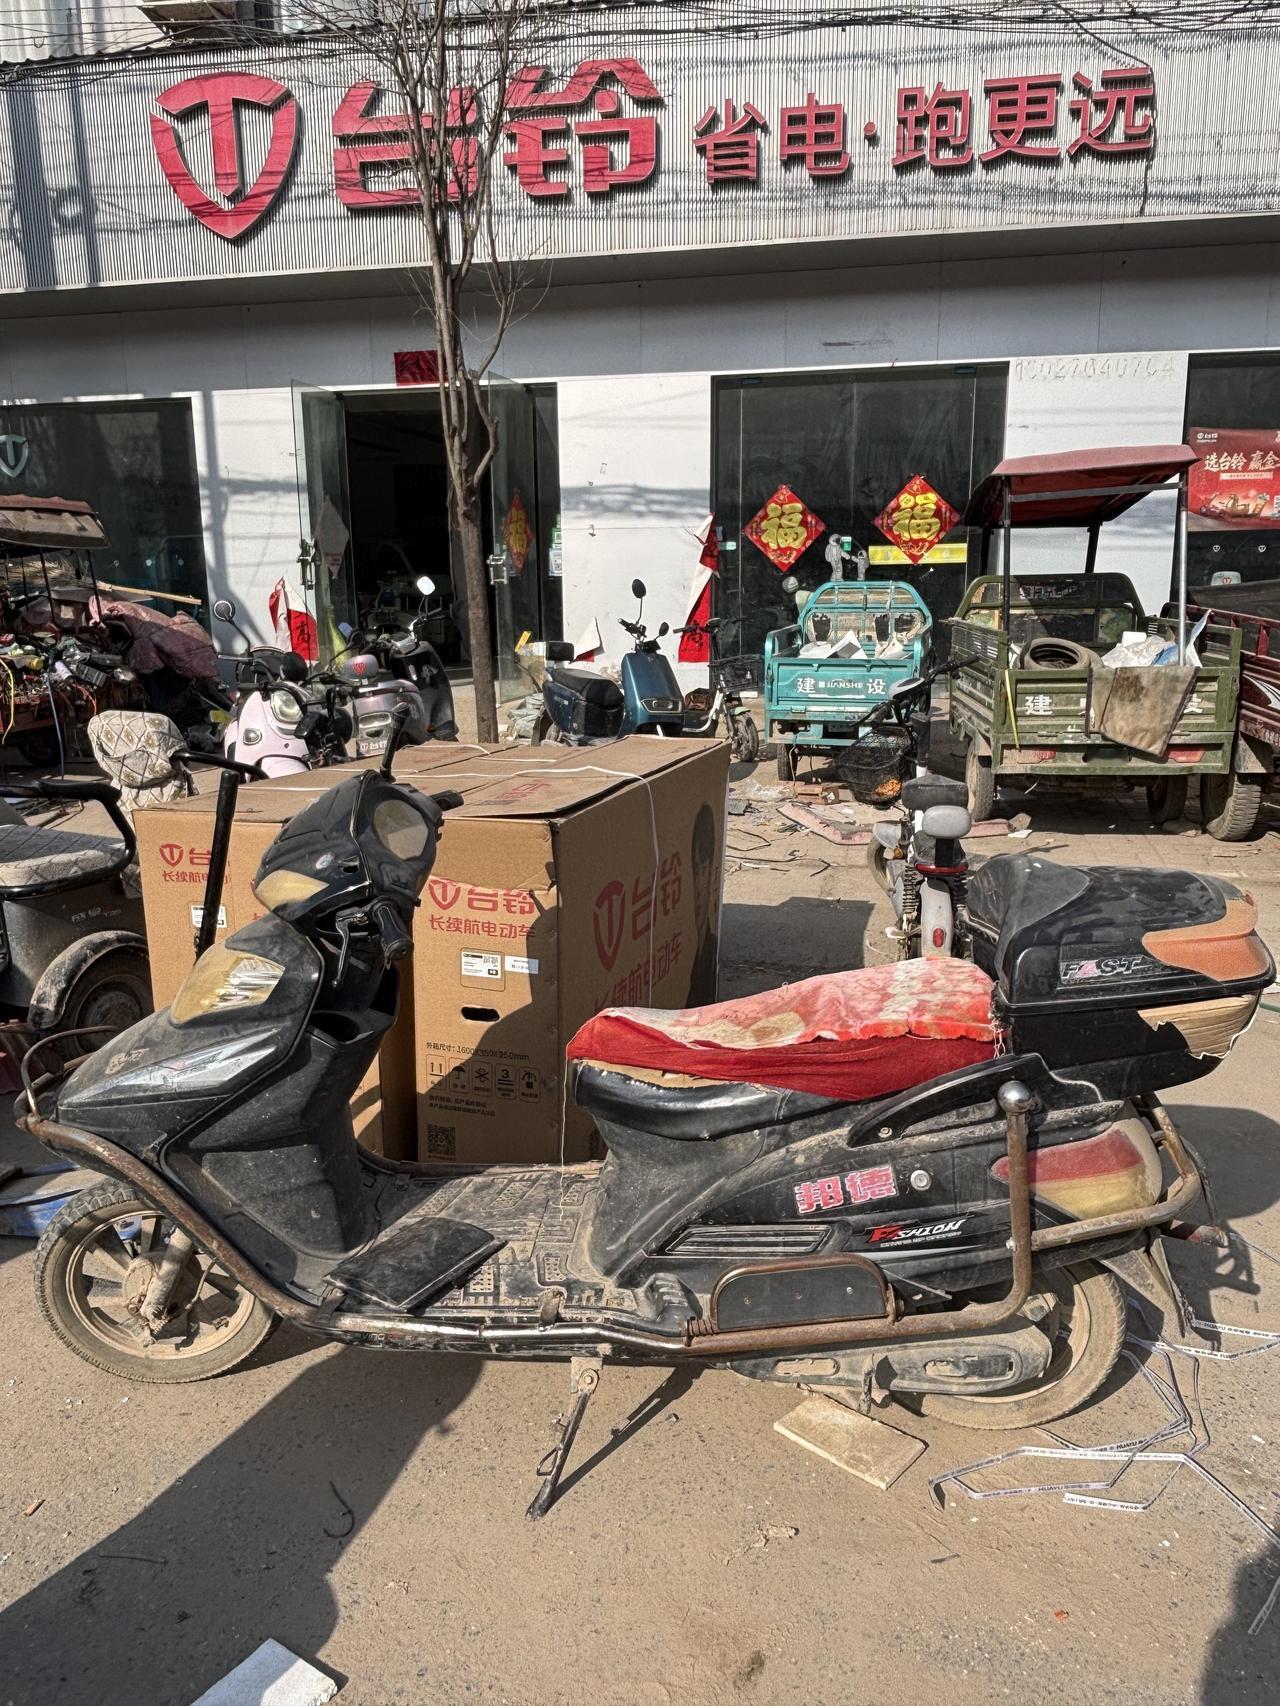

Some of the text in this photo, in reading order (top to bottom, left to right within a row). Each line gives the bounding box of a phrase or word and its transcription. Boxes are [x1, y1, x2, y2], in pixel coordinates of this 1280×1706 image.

[332, 57, 664, 209] 台铃
[1204, 452, 1247, 472] 选台铃
[761, 503, 808, 549] 福
[892, 493, 941, 541] 福
[796, 677, 816, 693] 建
[867, 678, 886, 695] 设
[1024, 694, 1053, 716] 建
[467, 887, 535, 915] 台铃
[429, 914, 537, 939] 长续航电动车
